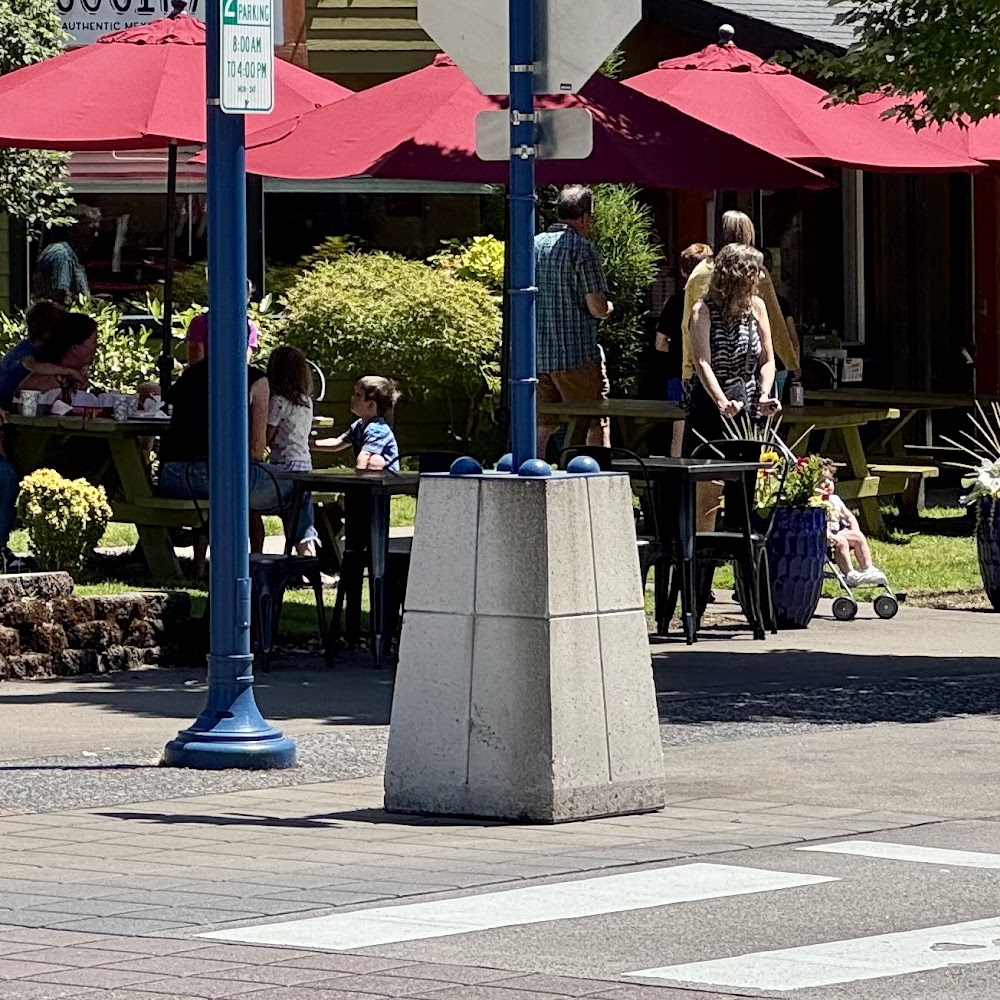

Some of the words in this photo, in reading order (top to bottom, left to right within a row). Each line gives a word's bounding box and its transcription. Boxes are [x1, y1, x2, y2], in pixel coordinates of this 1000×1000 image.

[238, 3, 269, 21] PARKING
[62, 21, 120, 30] AUTHENTIC
[227, 60, 236, 77] TO
[237, 60, 256, 78] 4:00
[257, 61, 267, 79] PM
